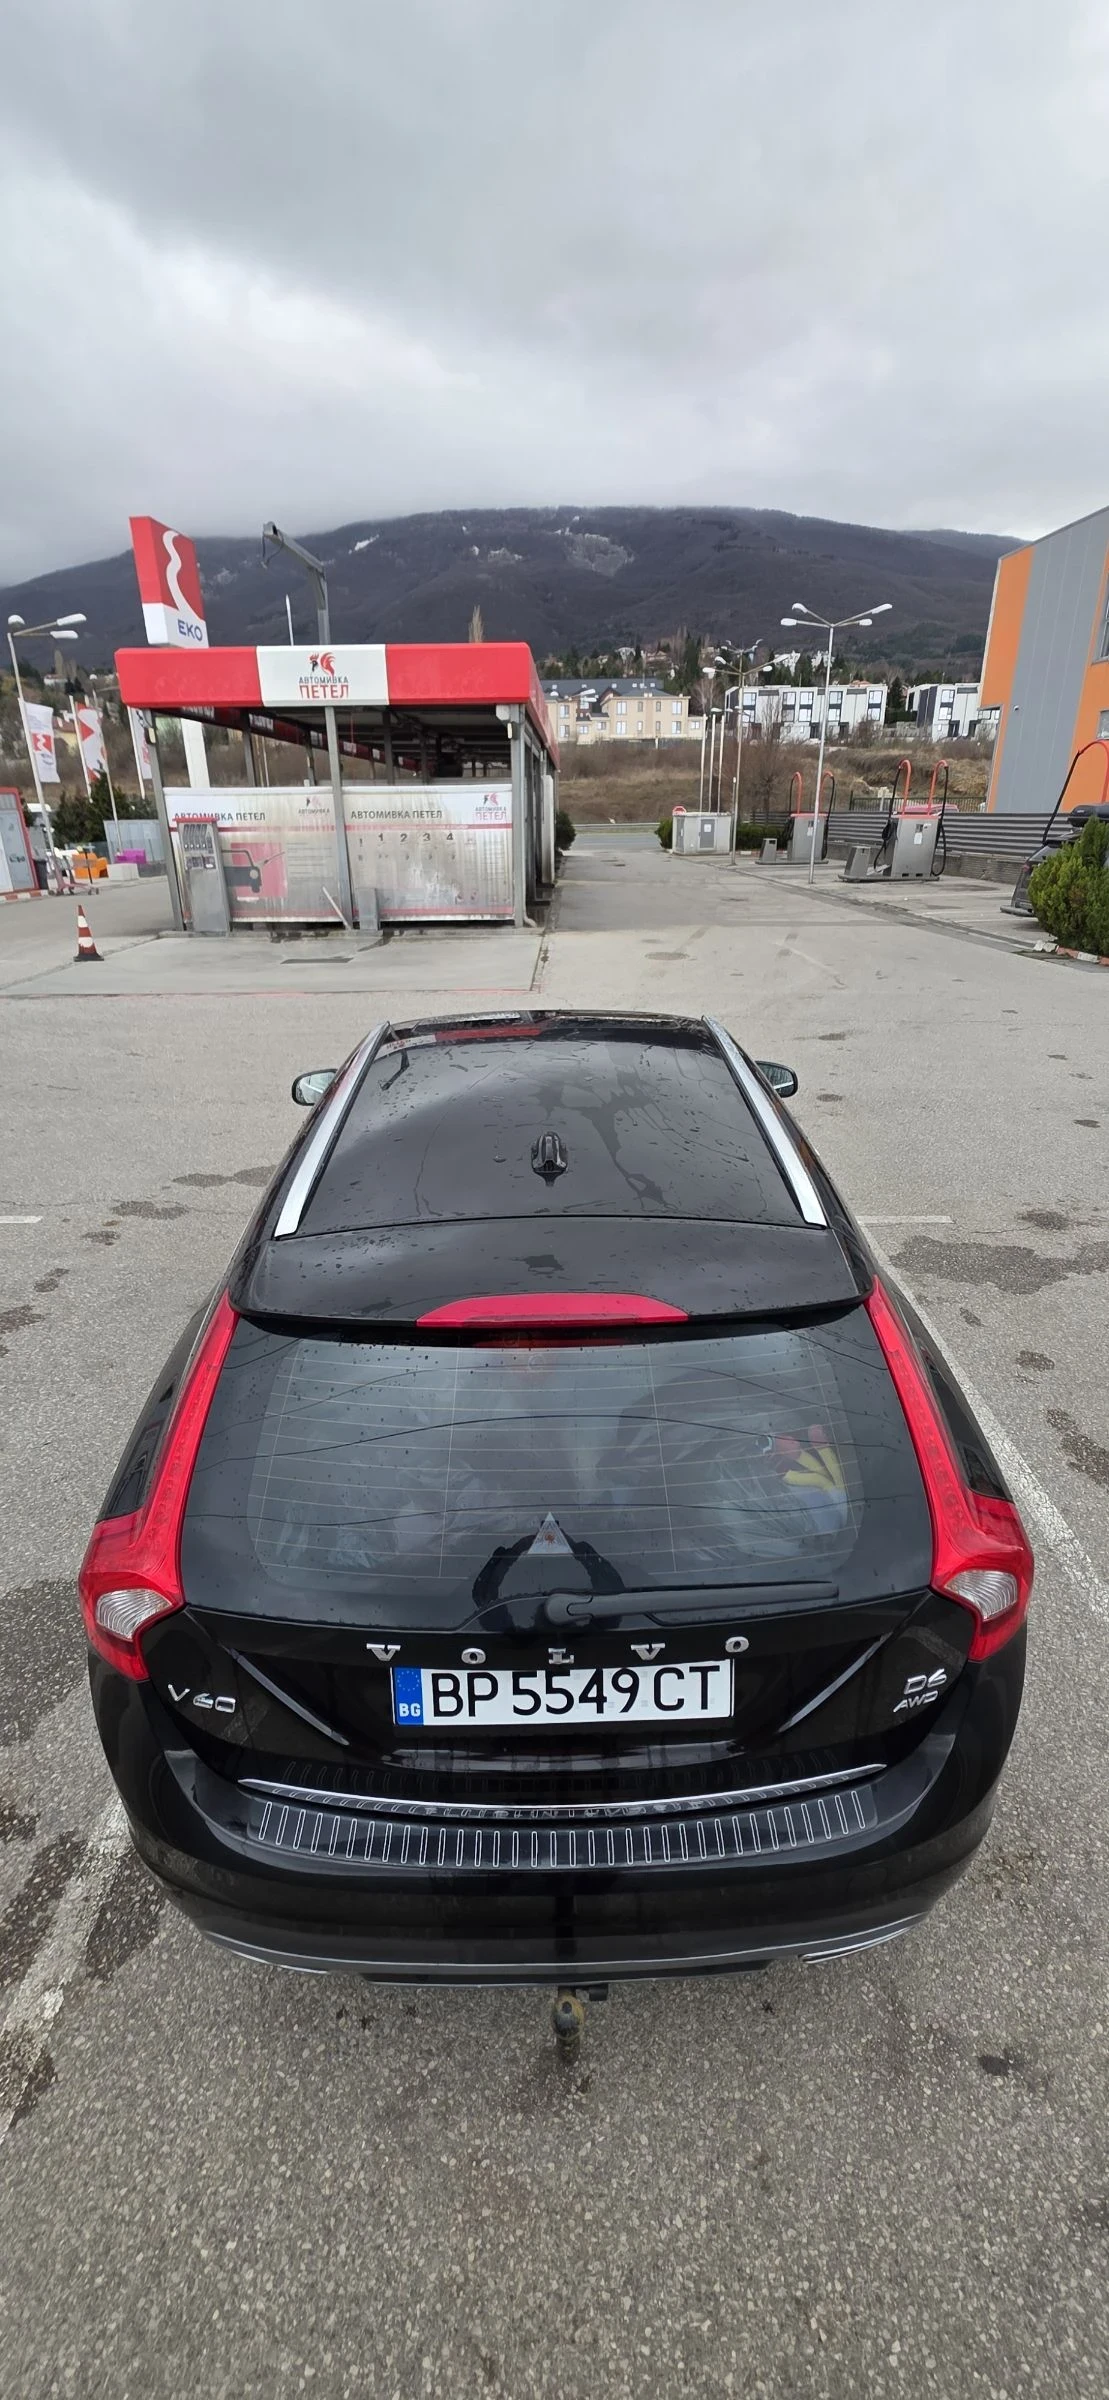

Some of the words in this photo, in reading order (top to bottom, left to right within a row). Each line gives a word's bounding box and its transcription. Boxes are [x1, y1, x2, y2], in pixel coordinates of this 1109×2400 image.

[177, 619, 203, 641] EKO
[299, 675, 348, 684] АВТОМИВКА
[299, 684, 348, 699] ПЕТЕЛ
[235, 812, 266, 821] ПЕТЕЛ
[351, 810, 411, 820] АВТОМИВКА
[412, 810, 442, 819] ПЕТЕЛ
[378, 833, 384, 841] 1
[400, 833, 408, 842] 2
[422, 832, 431, 841] 3
[446, 832, 454, 841] 4
[366, 1635, 750, 1664] VOLVO
[903, 1668, 947, 1695] D6
[167, 1683, 237, 1713] V60
[431, 1671, 499, 1718] BP
[512, 1667, 640, 1716] 5549
[653, 1664, 721, 1712] CT
[398, 1702, 421, 1717] BG
[893, 1690, 939, 1713] AWD
